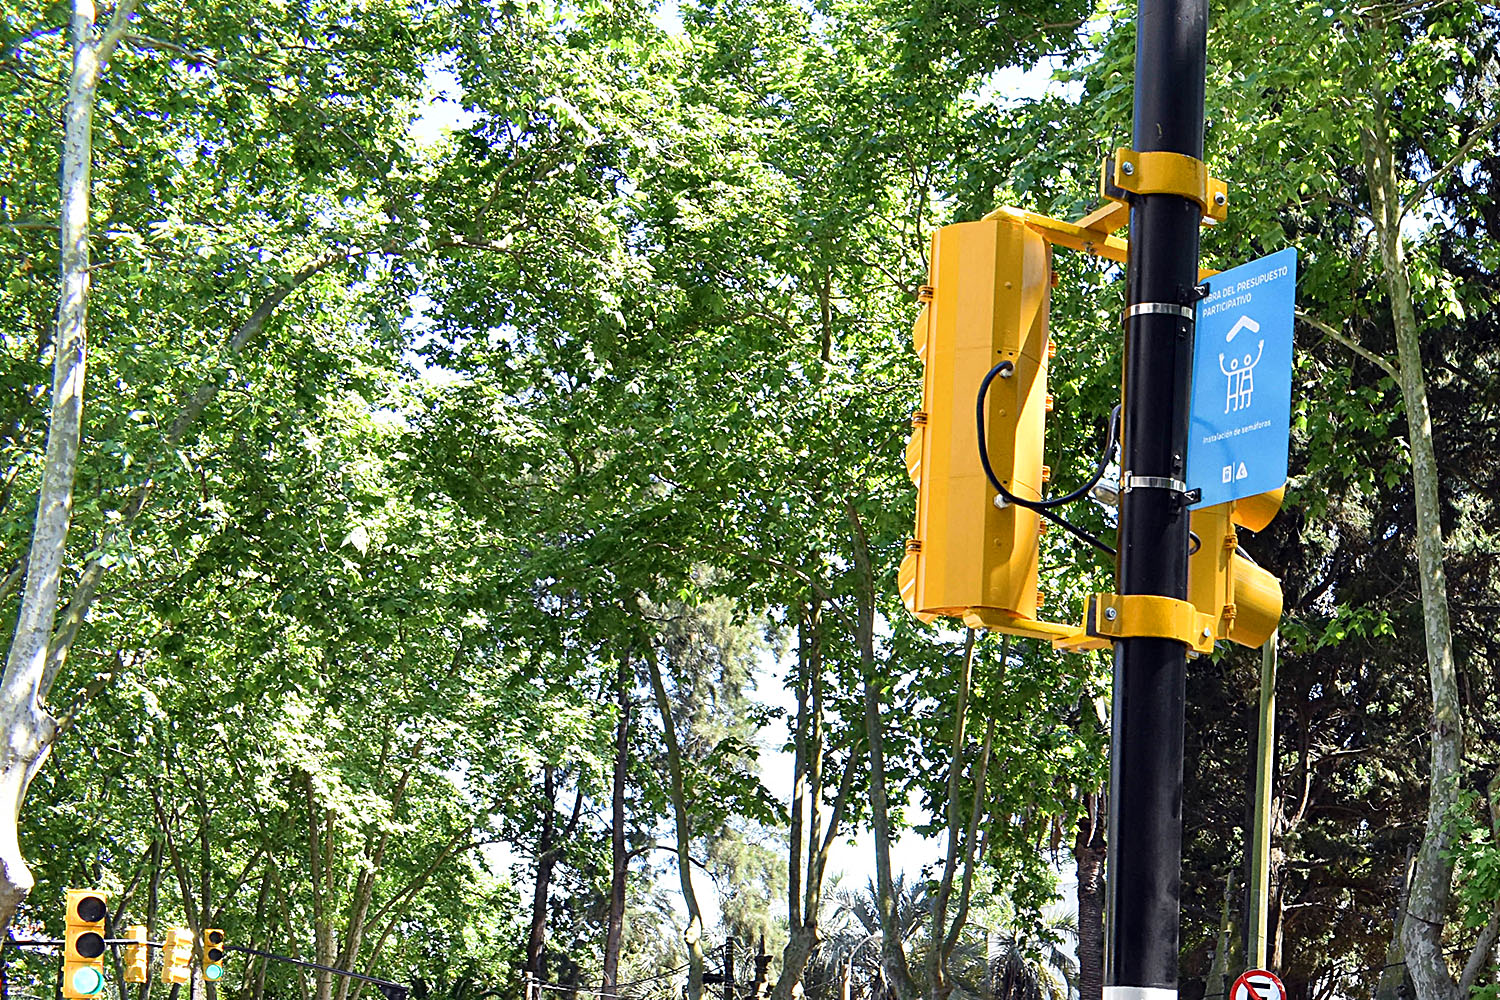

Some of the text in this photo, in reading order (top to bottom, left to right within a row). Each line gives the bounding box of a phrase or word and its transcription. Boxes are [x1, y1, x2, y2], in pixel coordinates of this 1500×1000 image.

[1222, 286, 1236, 298] DEL
[1237, 265, 1288, 292] PRESUPUESTO
[1202, 292, 1252, 318] PARTICIPATIVO
[1233, 428, 1241, 436] de
